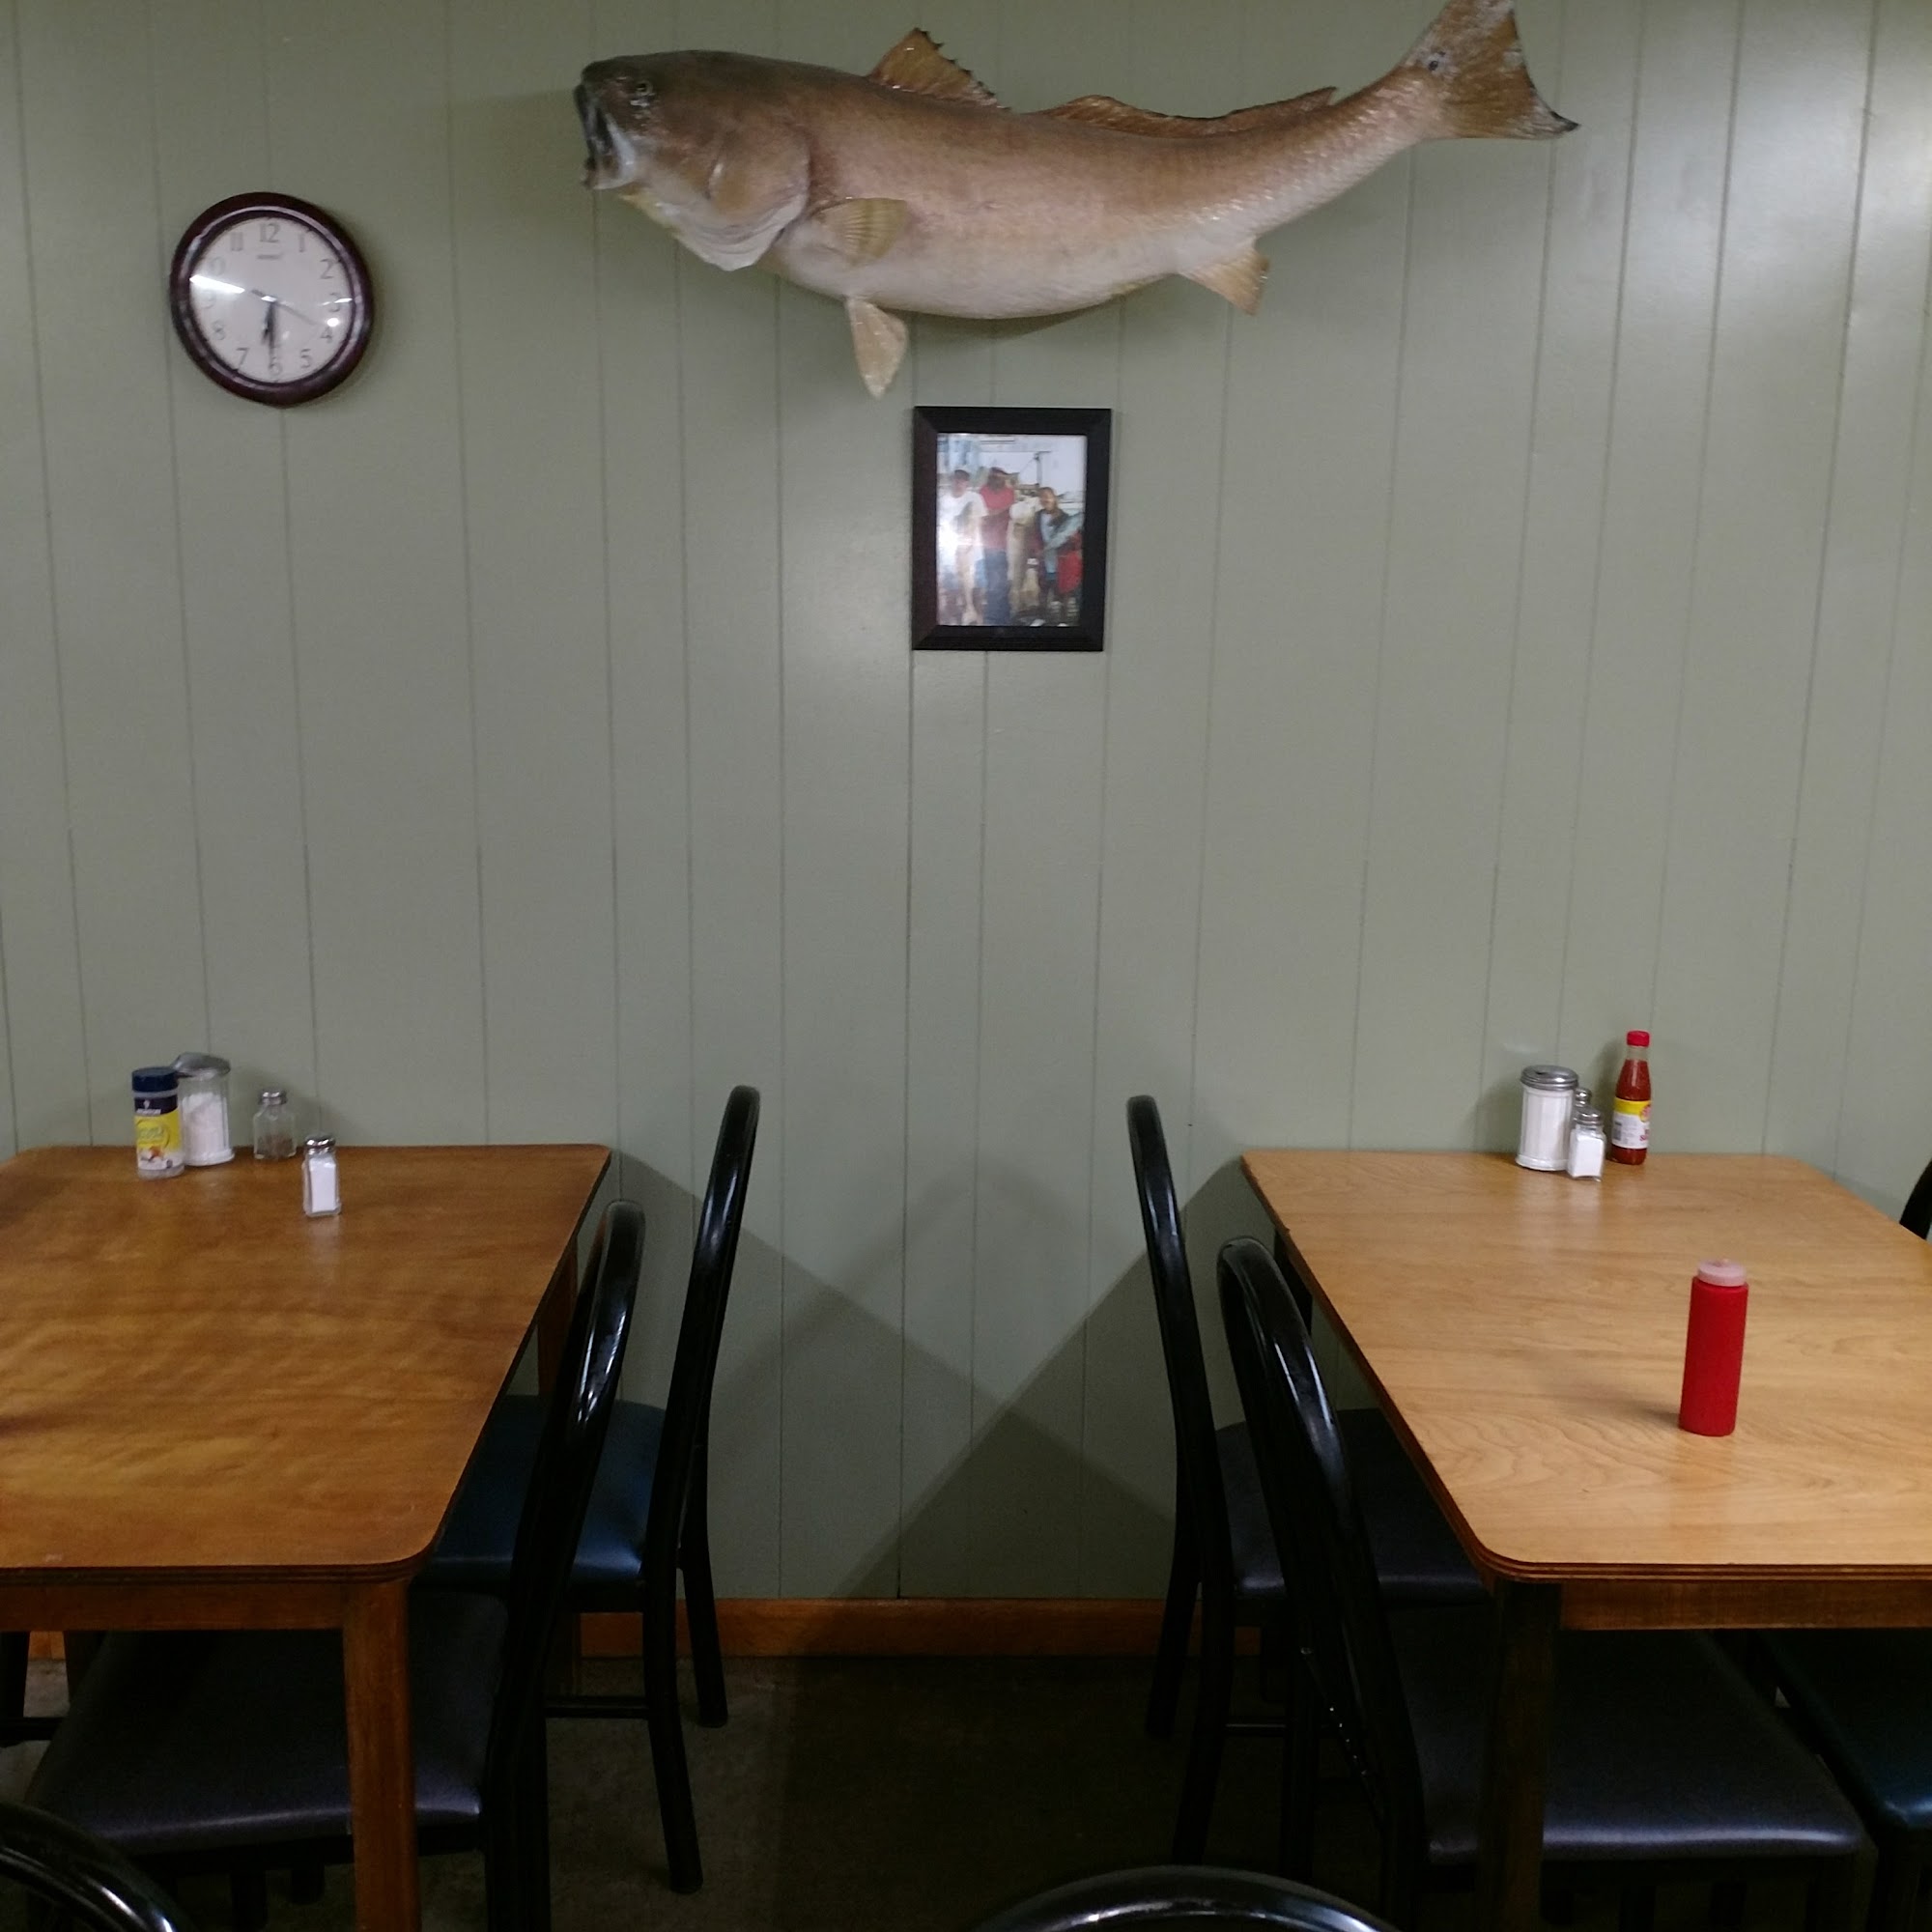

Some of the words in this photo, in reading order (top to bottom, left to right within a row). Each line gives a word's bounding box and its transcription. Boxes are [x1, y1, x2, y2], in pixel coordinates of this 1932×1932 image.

[259, 222, 281, 242] 12
[299, 233, 307, 253] 1
[320, 258, 334, 279] 2
[236, 347, 250, 367] 7
[269, 355, 283, 377] 6
[300, 349, 312, 369] 5
